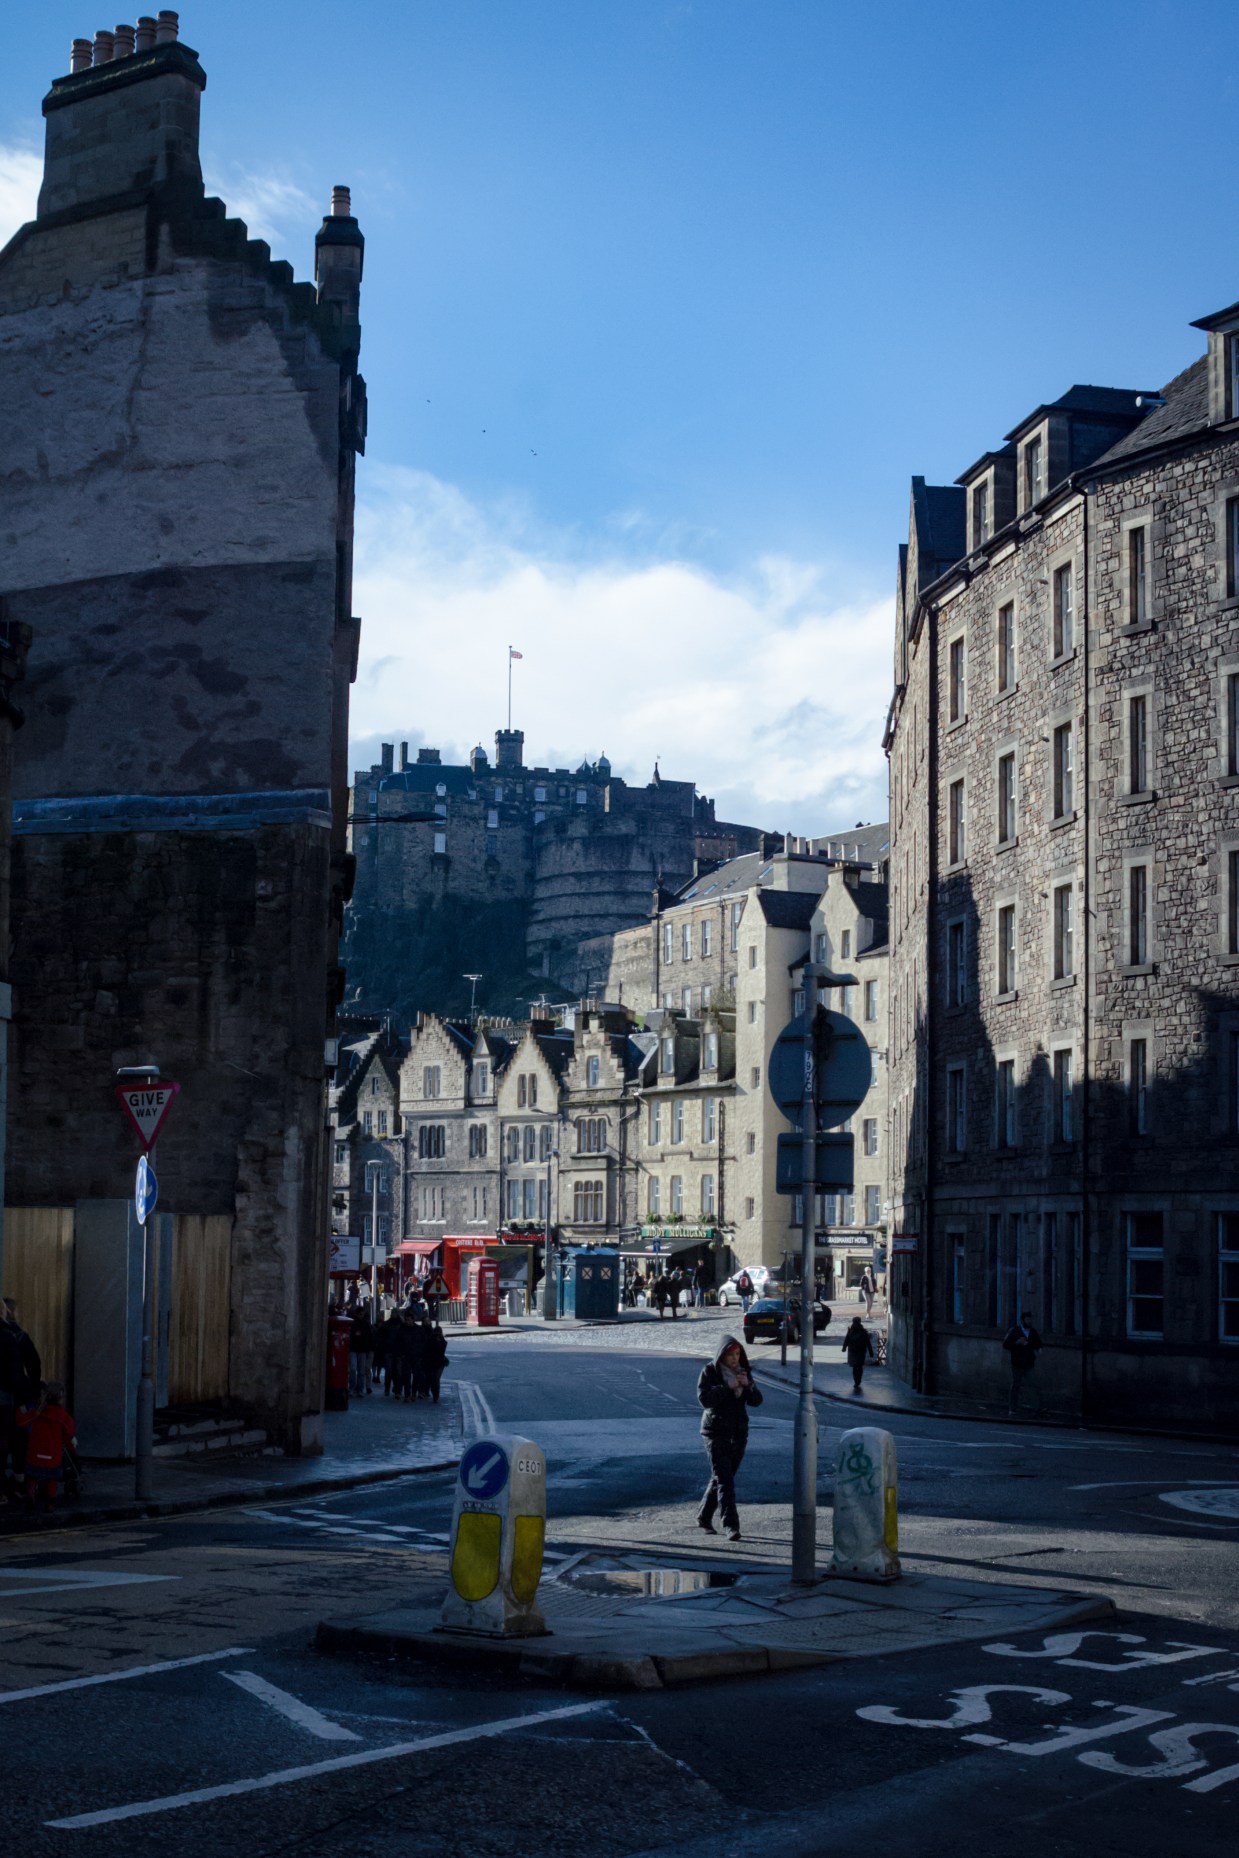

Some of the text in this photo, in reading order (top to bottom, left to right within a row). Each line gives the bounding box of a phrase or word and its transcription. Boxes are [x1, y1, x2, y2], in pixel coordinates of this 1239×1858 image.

[129, 1092, 164, 1106] GIVE
[136, 1107, 157, 1117] WAY
[670, 1228, 707, 1238] MULLIGANS
